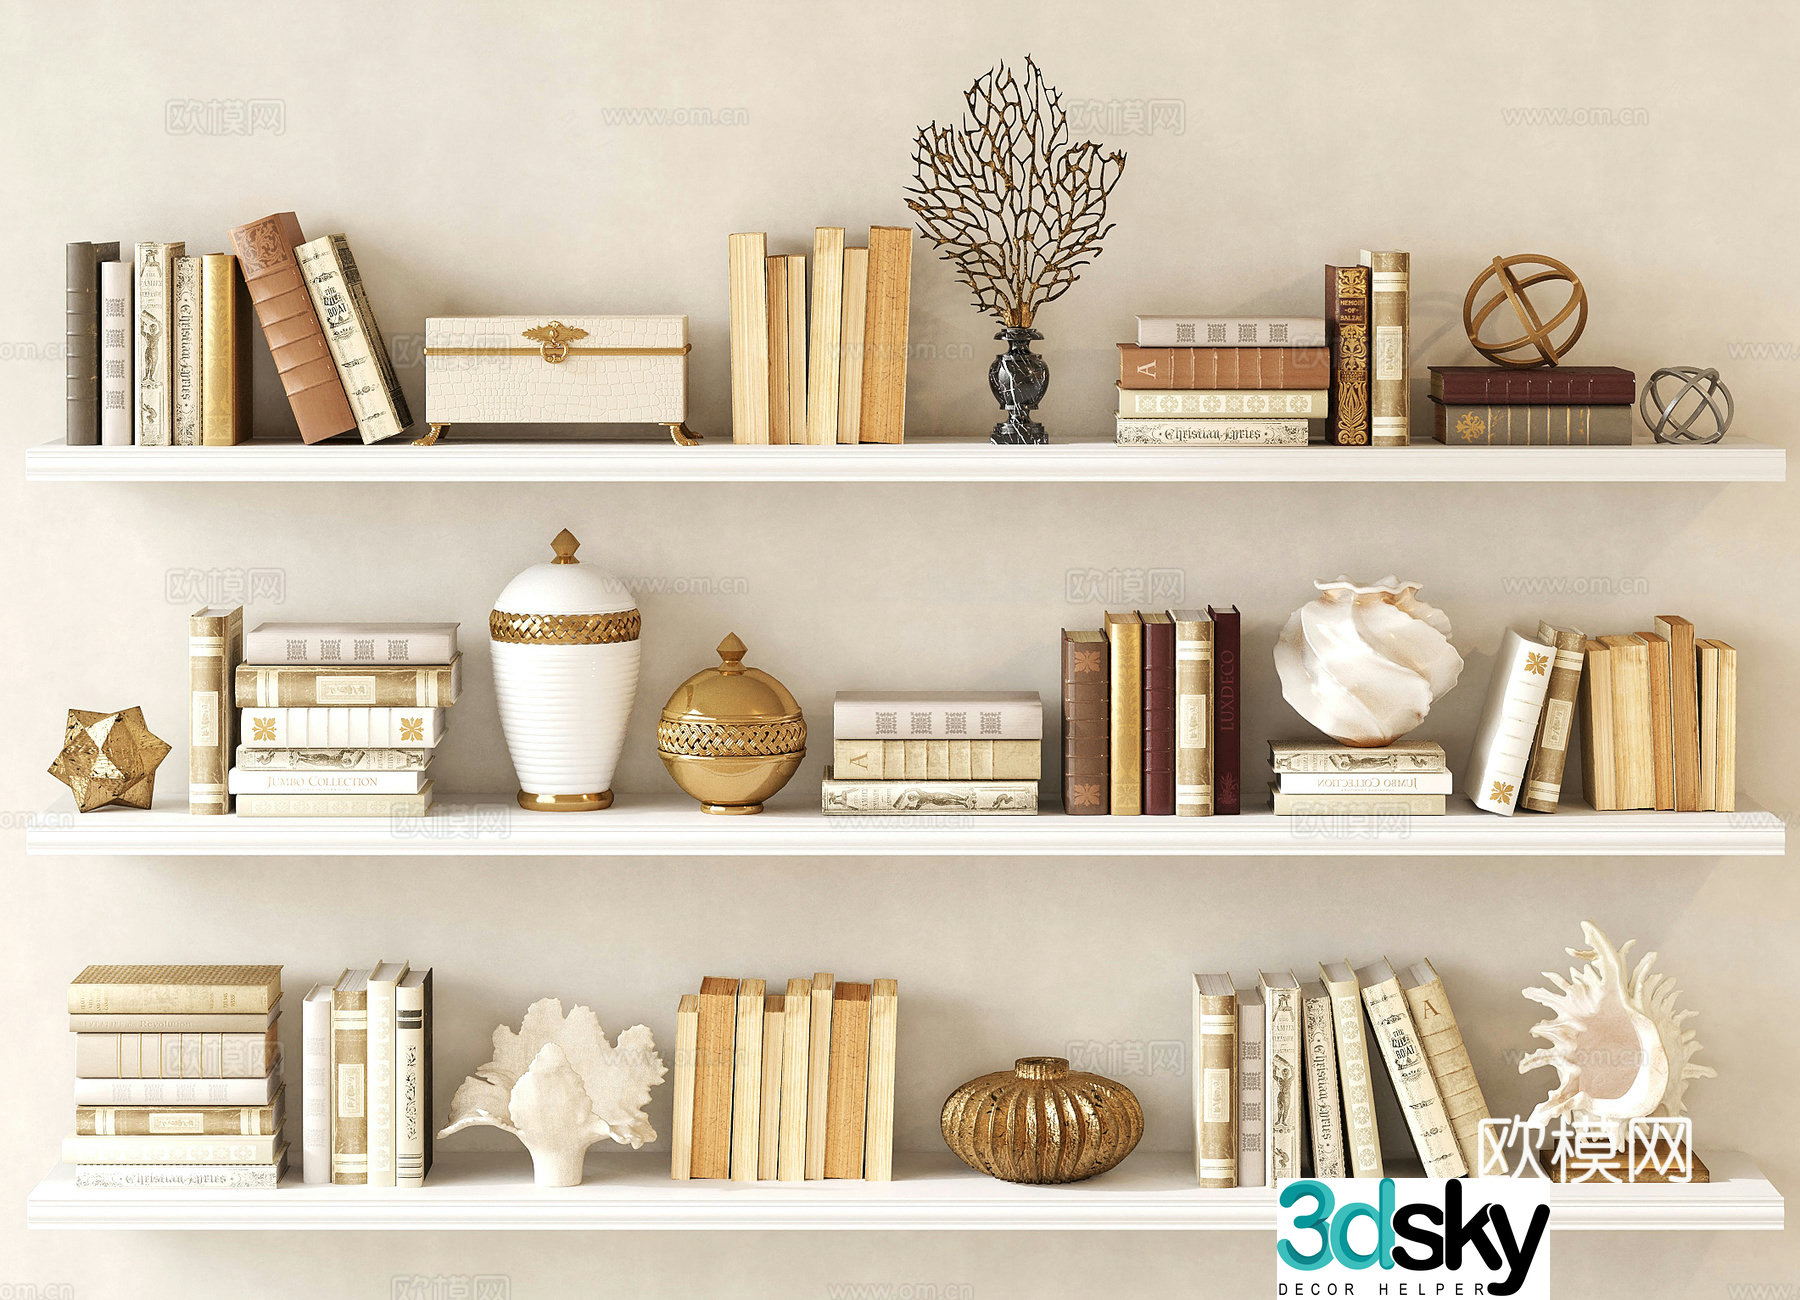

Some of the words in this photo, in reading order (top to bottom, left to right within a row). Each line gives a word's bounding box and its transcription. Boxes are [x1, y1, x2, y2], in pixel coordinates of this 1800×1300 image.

[1137, 360, 1157, 379] A
[1221, 650, 1234, 730] LUXDECO
[849, 752, 868, 771] A
[267, 775, 305, 788] JUMBO
[308, 775, 378, 788] COLLECTION
[1422, 1000, 1441, 1020] A
